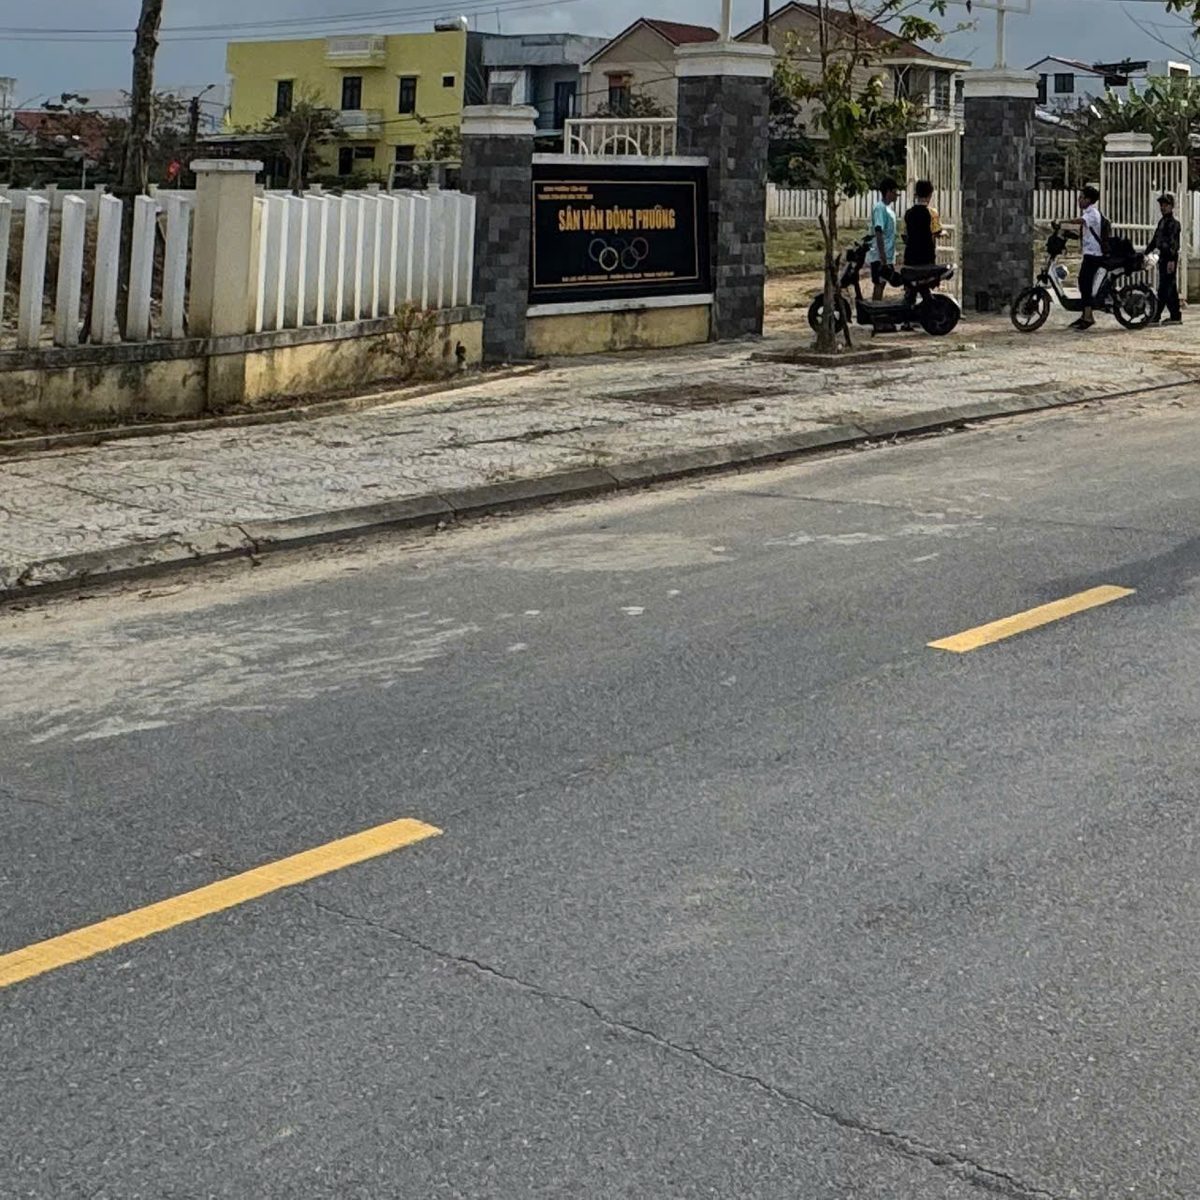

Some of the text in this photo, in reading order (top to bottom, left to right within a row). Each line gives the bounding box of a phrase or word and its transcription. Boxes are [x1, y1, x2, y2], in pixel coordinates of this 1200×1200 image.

[558, 205, 581, 232] SÂN
[582, 205, 604, 234] VẬN
[606, 204, 634, 234] ĐỘNG
